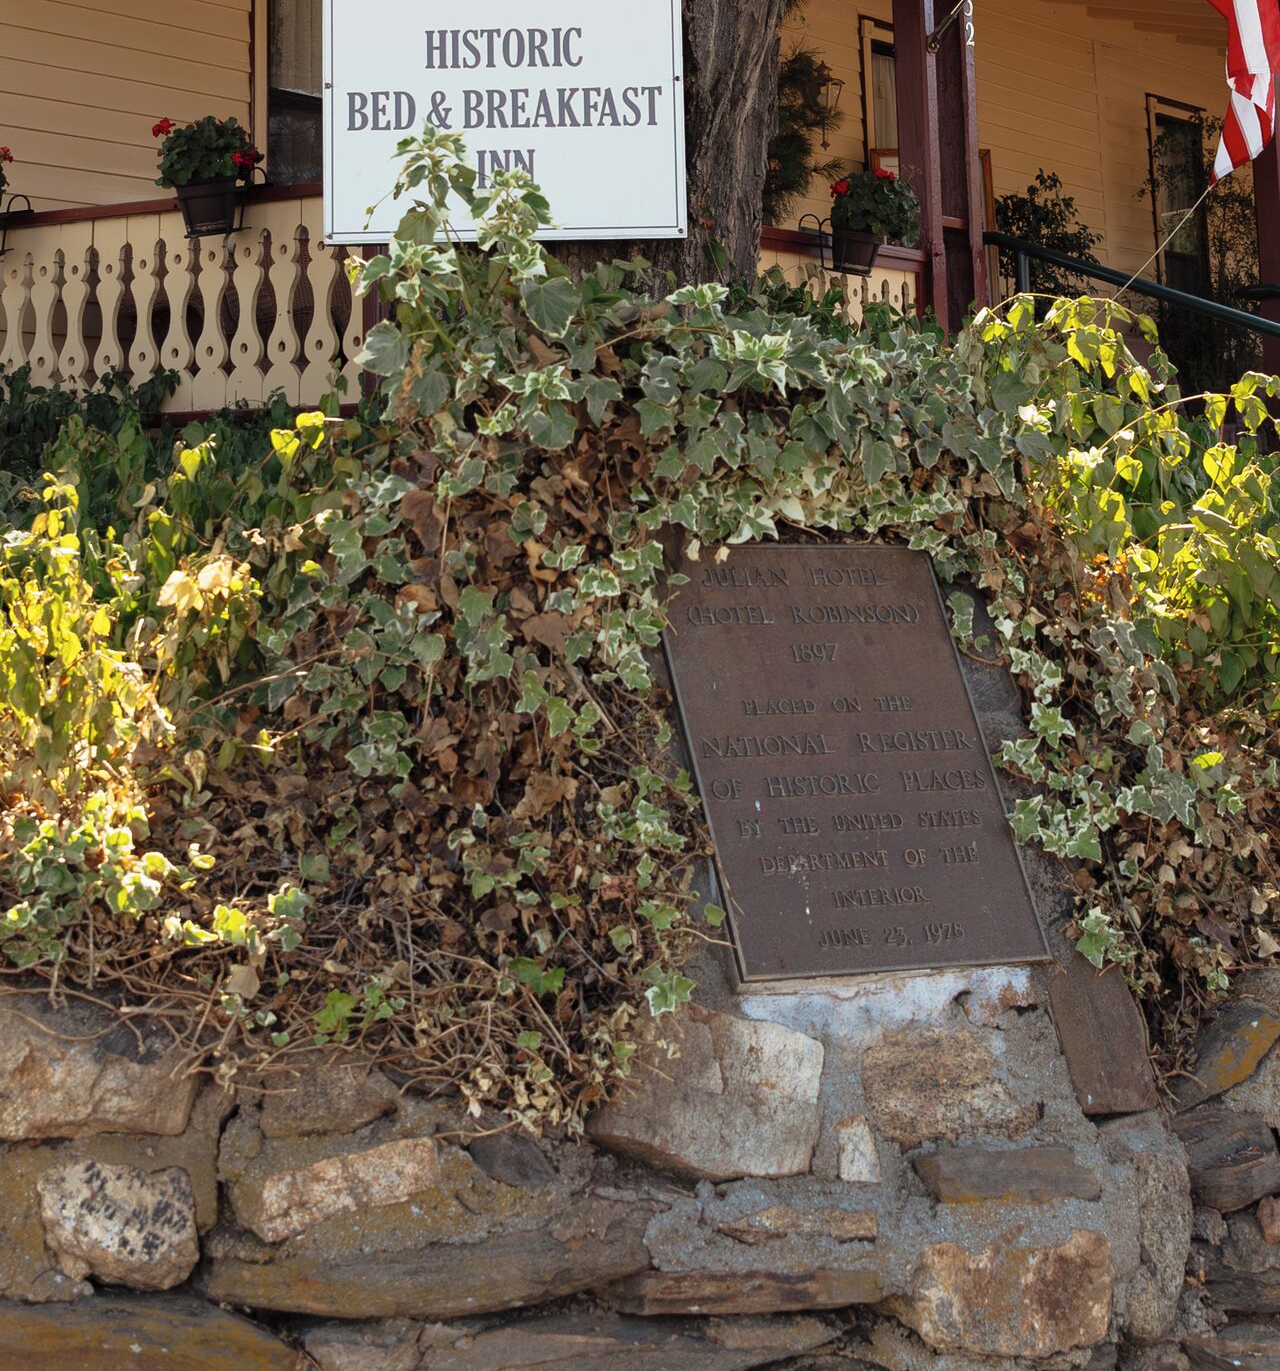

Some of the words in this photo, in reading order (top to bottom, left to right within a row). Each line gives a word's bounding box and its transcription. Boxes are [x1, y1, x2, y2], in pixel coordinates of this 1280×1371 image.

[424, 27, 584, 69] HISTORIC
[346, 90, 416, 131] BED
[426, 90, 453, 130] &
[462, 86, 663, 129] BREAKFAST
[702, 567, 790, 588] JULIAN
[812, 566, 888, 587] HOTEL
[686, 604, 775, 627] (HOTEL
[789, 603, 920, 626] ROBINSON)
[790, 643, 838, 663] 1897
[743, 698, 816, 716] PLACED
[833, 696, 863, 714] ON
[873, 695, 913, 712] THE
[699, 733, 836, 759] NATIONAL
[859, 729, 974, 753] REGISTER
[711, 778, 744, 801] OF
[767, 773, 881, 799] HISTORIC
[900, 768, 987, 792] PLACES
[736, 818, 762, 837] BY
[779, 816, 819, 835] THE
[833, 811, 904, 831] UNITED
[919, 808, 982, 828] STATES
[761, 850, 888, 875] DEPARTMENT
[903, 848, 928, 867] OF
[939, 845, 980, 864] THE
[832, 886, 930, 908] INTERIOR
[818, 928, 872, 949] JUNE
[924, 922, 965, 943] 1978
